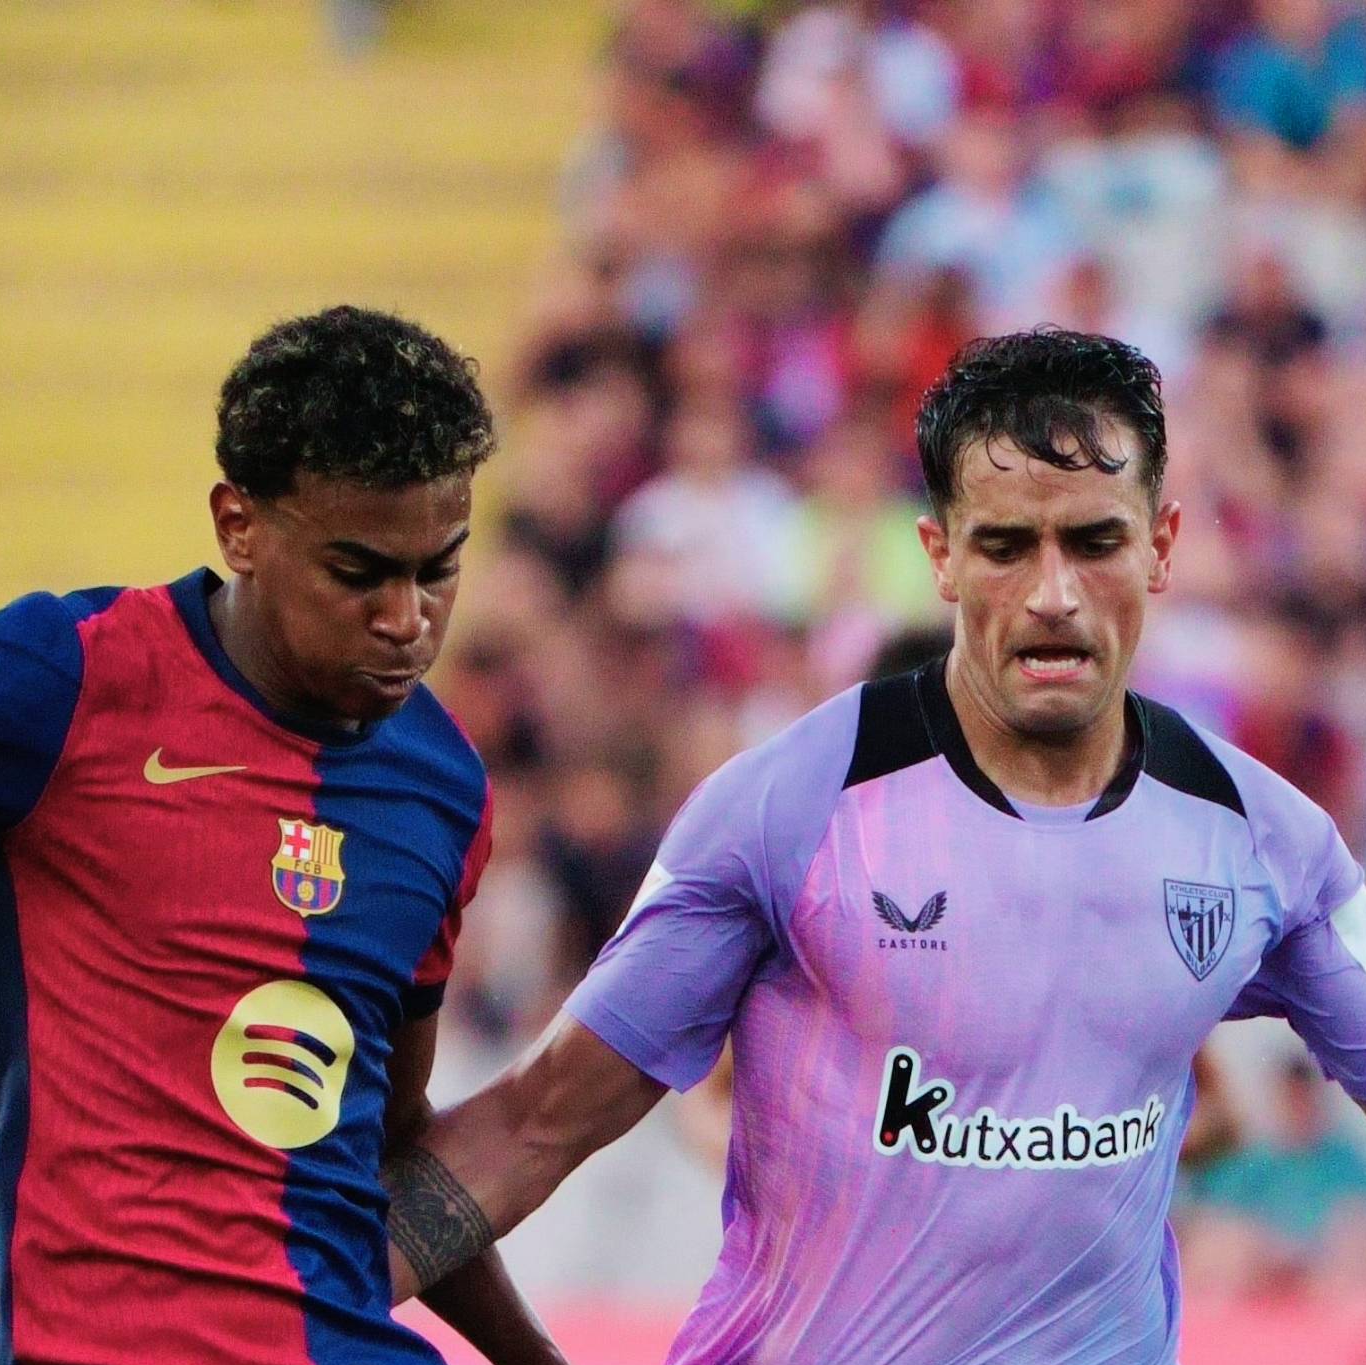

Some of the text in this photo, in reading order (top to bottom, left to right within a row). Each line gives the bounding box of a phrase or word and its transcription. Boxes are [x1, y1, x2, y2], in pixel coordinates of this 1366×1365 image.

[294, 860, 322, 875] FCB
[1169, 884, 1230, 899] ATHLETIC CLUB
[879, 938, 947, 951] CASTORE
[1186, 950, 1217, 976] BILBAO
[880, 1053, 1161, 1161] Kutxabank
